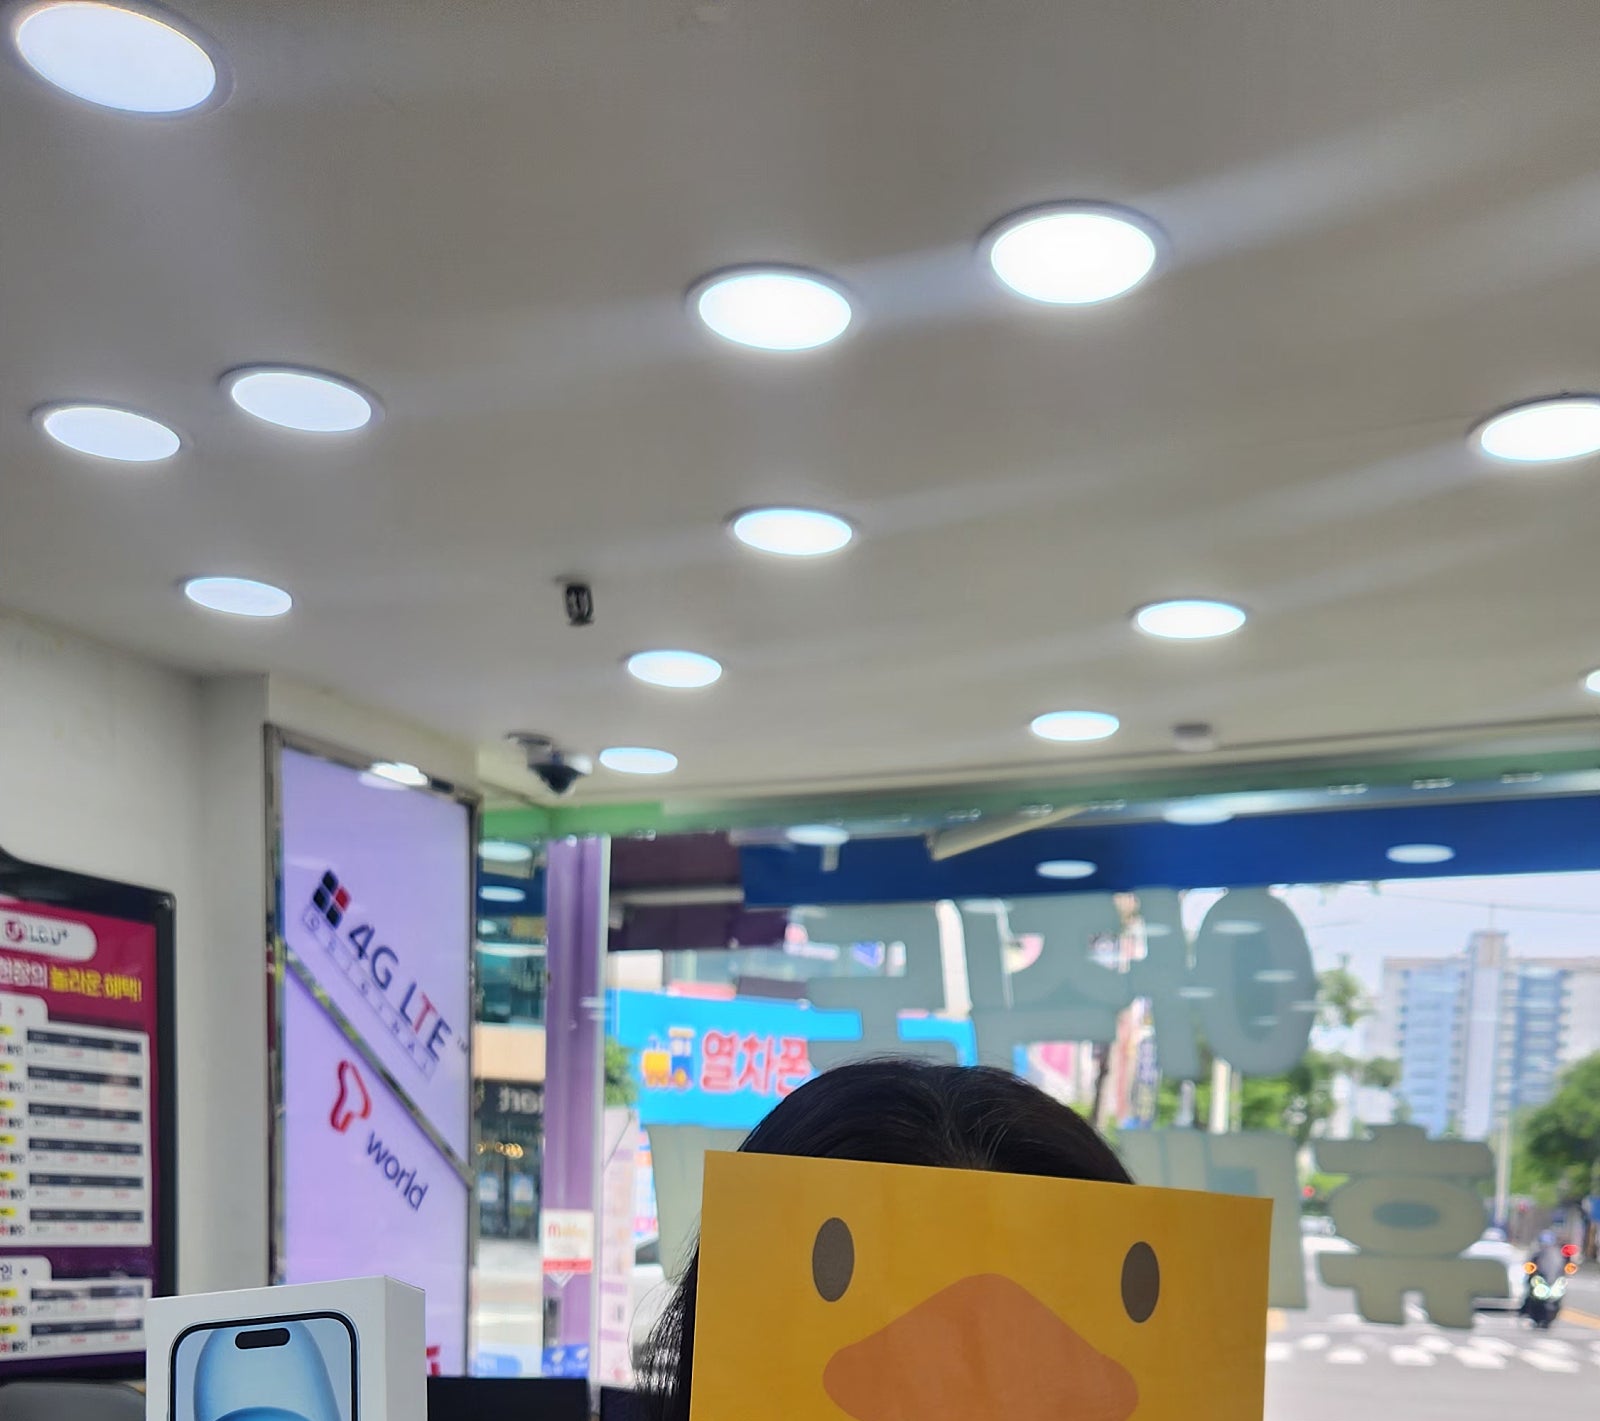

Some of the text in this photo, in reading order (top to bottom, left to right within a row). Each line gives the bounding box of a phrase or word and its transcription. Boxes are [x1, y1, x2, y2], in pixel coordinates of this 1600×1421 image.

[349, 924, 400, 991] 4G
[400, 981, 452, 1063] LTE
[367, 1130, 429, 1211] world
